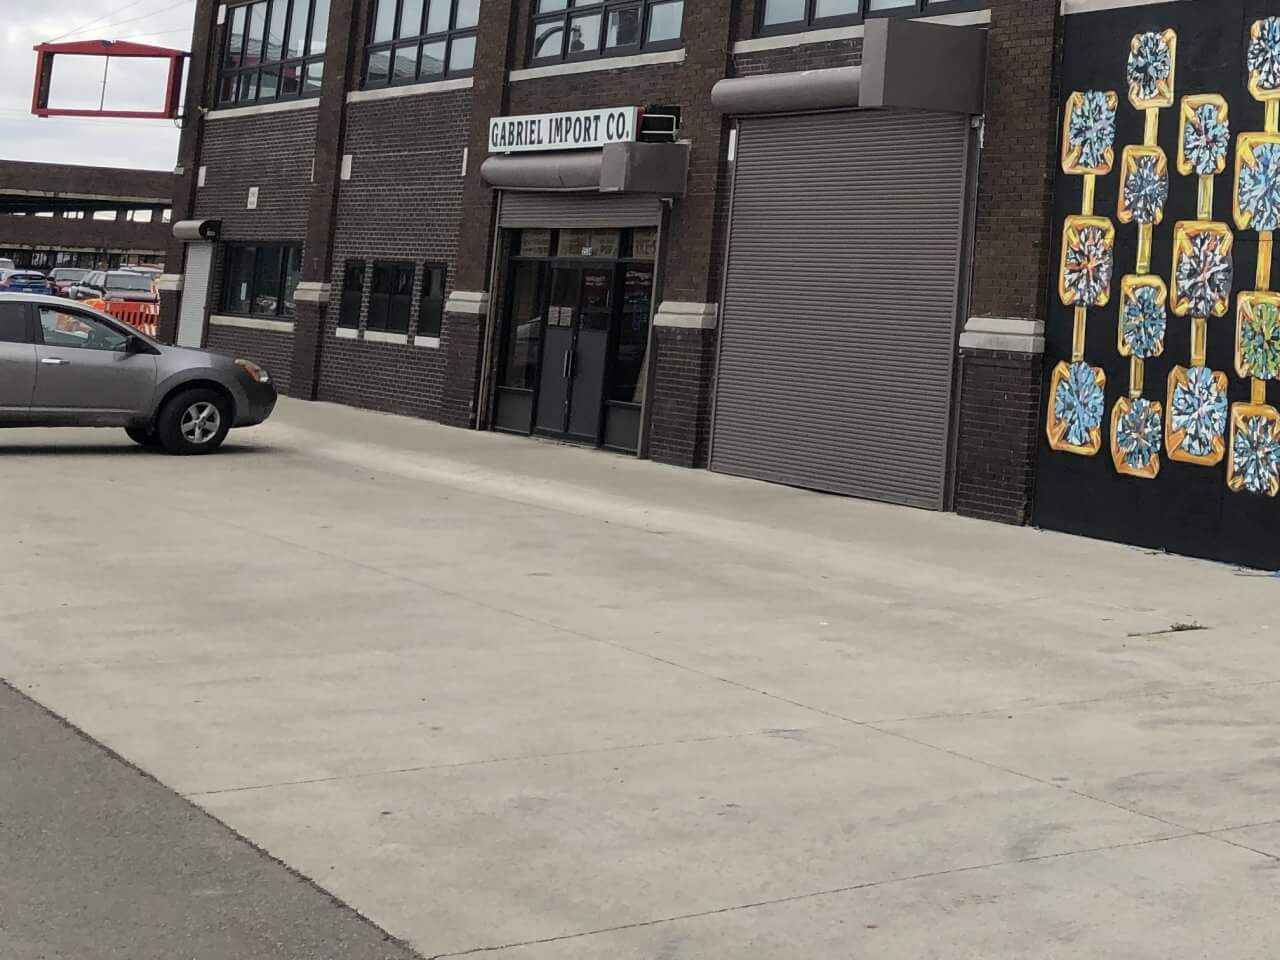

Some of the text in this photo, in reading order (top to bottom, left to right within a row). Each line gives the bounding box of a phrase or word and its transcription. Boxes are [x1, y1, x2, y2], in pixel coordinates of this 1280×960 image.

[491, 111, 630, 147] GABRIEL IMPORT CO.
